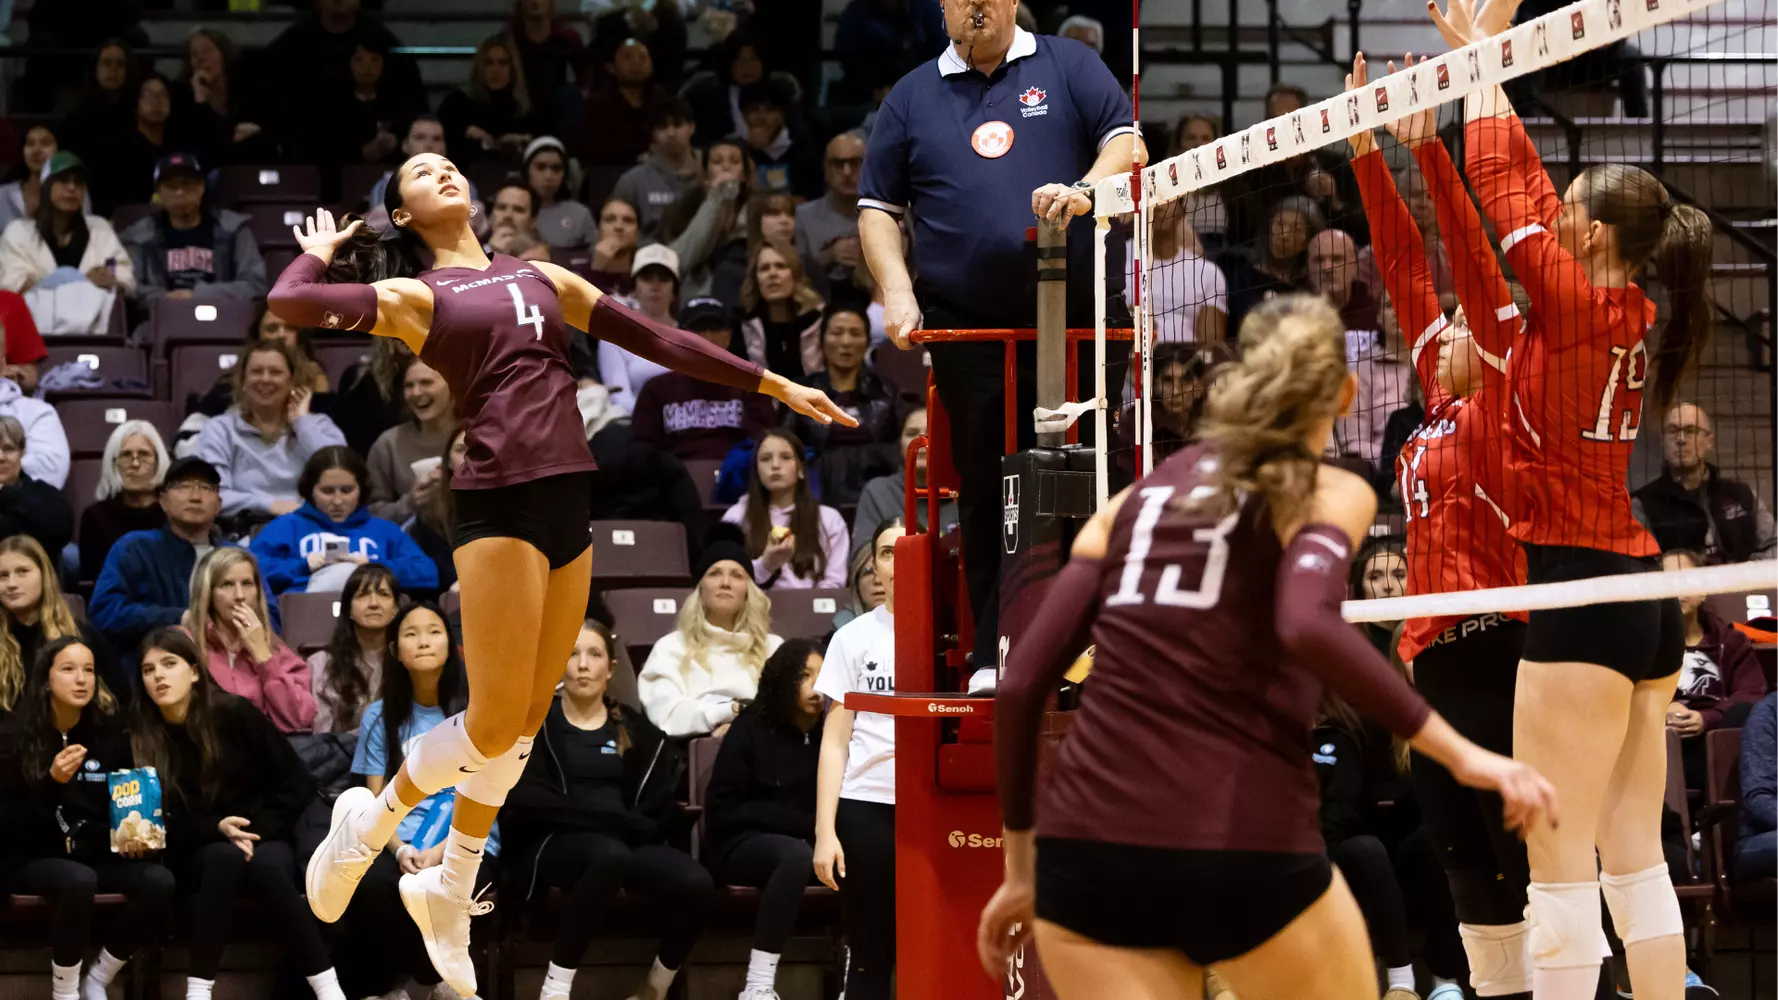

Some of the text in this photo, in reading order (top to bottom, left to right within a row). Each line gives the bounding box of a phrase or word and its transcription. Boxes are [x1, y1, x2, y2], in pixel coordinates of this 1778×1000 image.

[1020, 105, 1048, 114] Volleyball
[1022, 110, 1047, 118] Canada
[506, 282, 545, 341] 4
[1105, 485, 1248, 610] 13
[937, 702, 974, 713] Senoh
[116, 793, 142, 809] CORN
